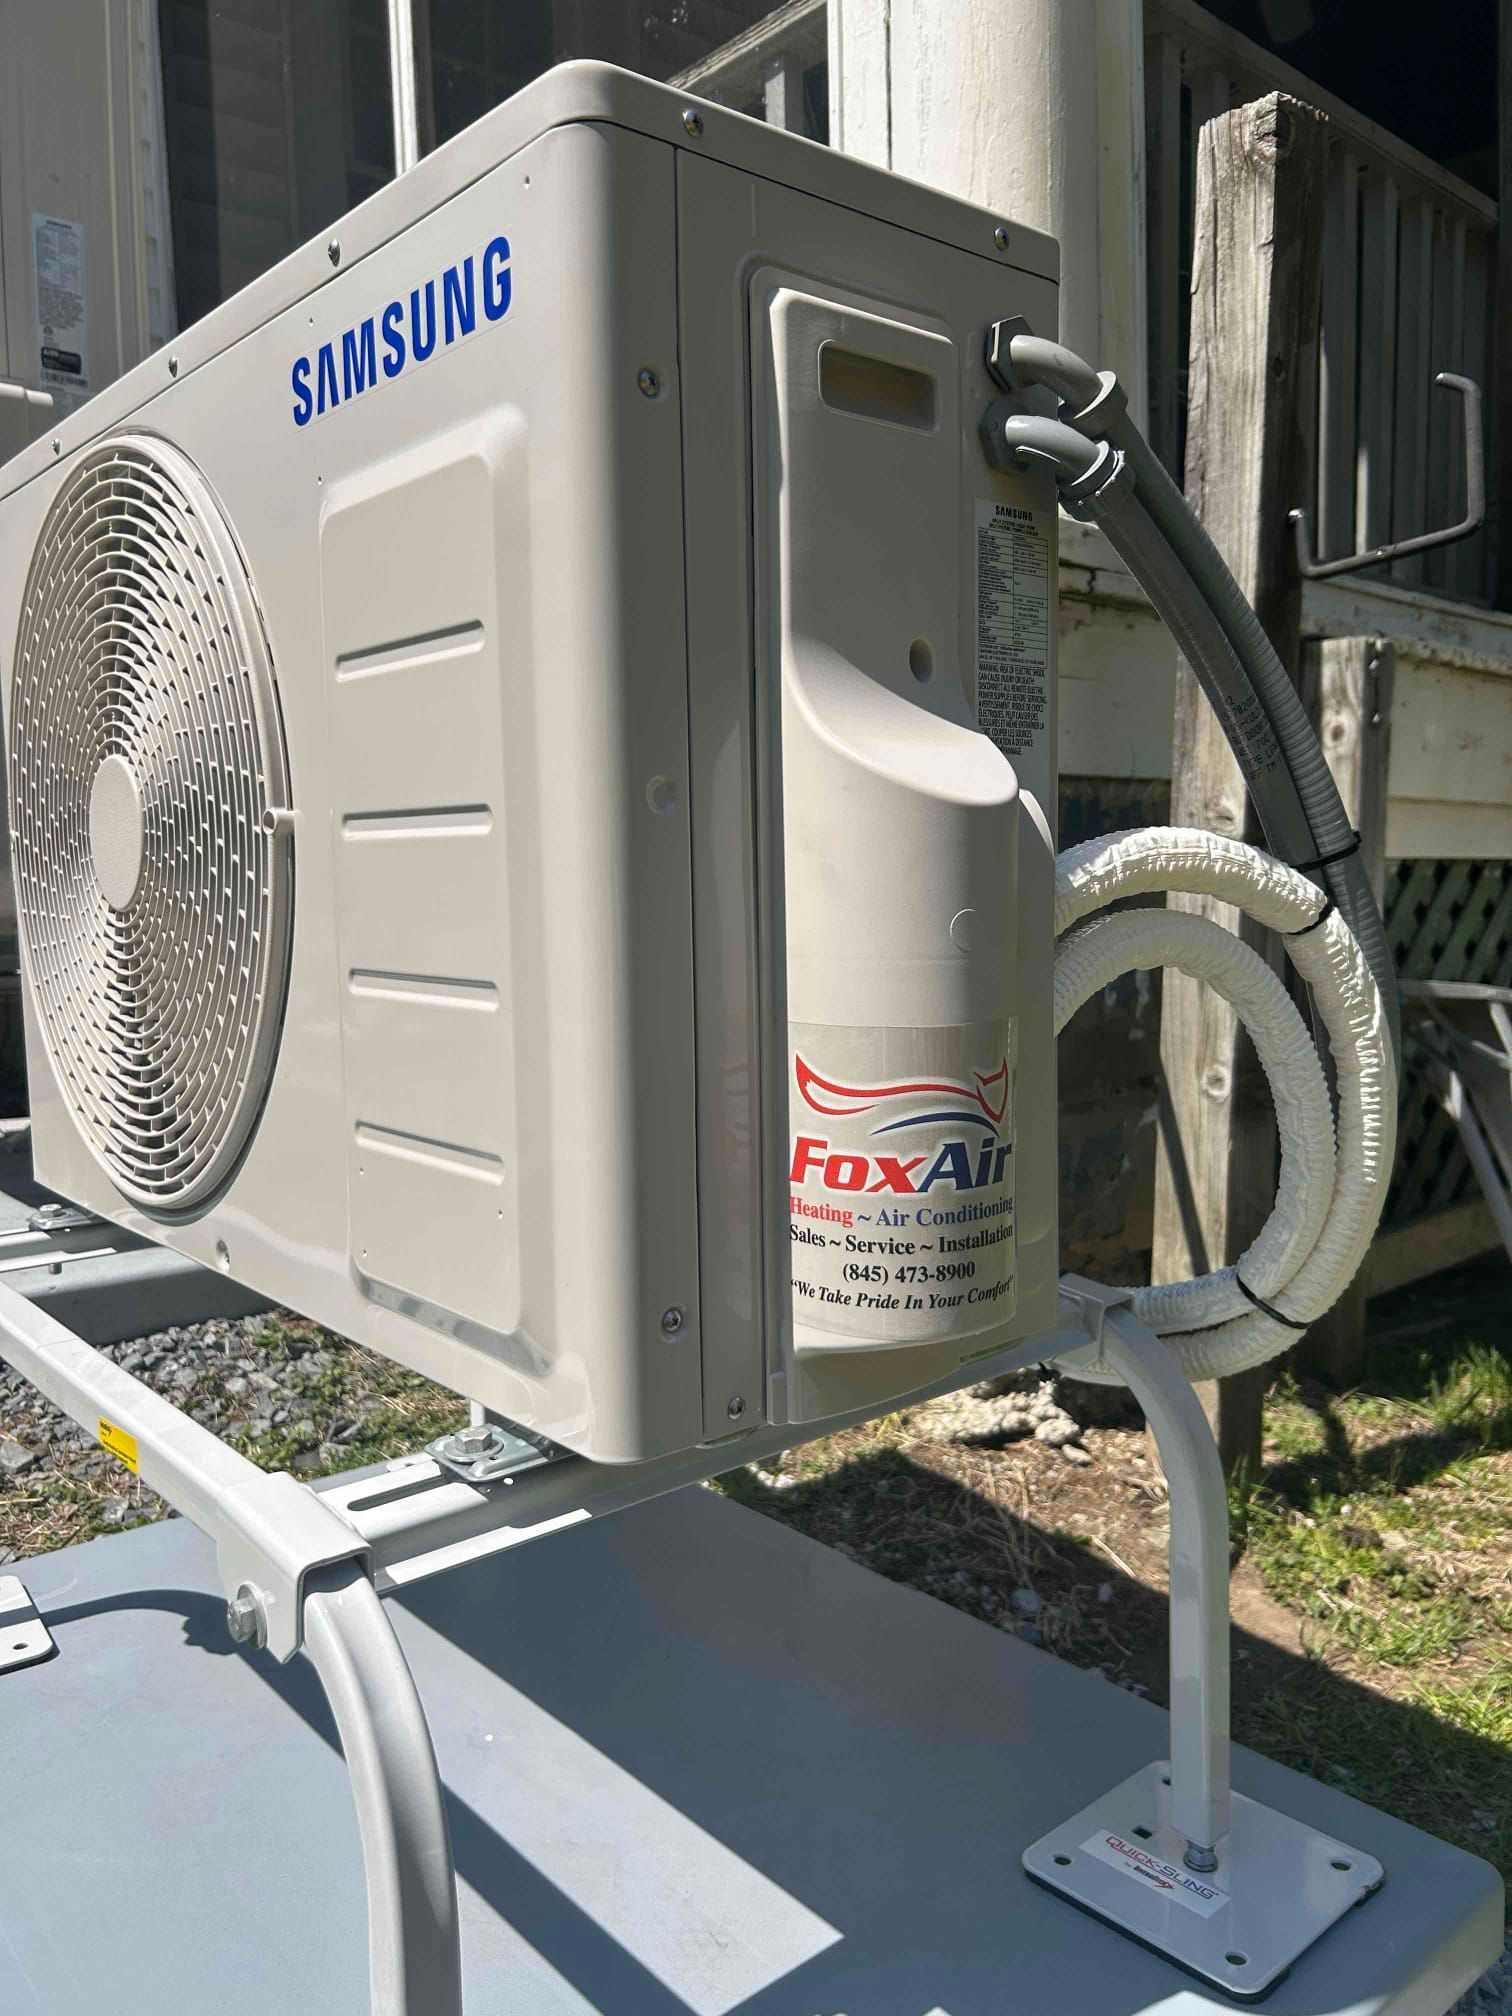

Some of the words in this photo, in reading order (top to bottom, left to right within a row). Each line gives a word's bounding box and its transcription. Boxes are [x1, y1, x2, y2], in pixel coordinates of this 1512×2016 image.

[292, 236, 512, 427] SAMSUNG
[995, 505, 1033, 521] SAMSUNG
[788, 1136, 1013, 1193] FoxAir
[789, 1196, 854, 1228] Heating
[876, 1208, 910, 1227] Air
[916, 1197, 1013, 1227] Conditioning
[789, 1224, 826, 1247] Sales
[845, 1234, 916, 1255] Service
[938, 1224, 1013, 1254] Installation
[842, 1263, 889, 1286] (845)
[895, 1261, 976, 1283] 473-8900
[818, 1287, 851, 1306] Take
[856, 1291, 900, 1310] Pride
[904, 1294, 923, 1310] In
[928, 1291, 965, 1310] Your
